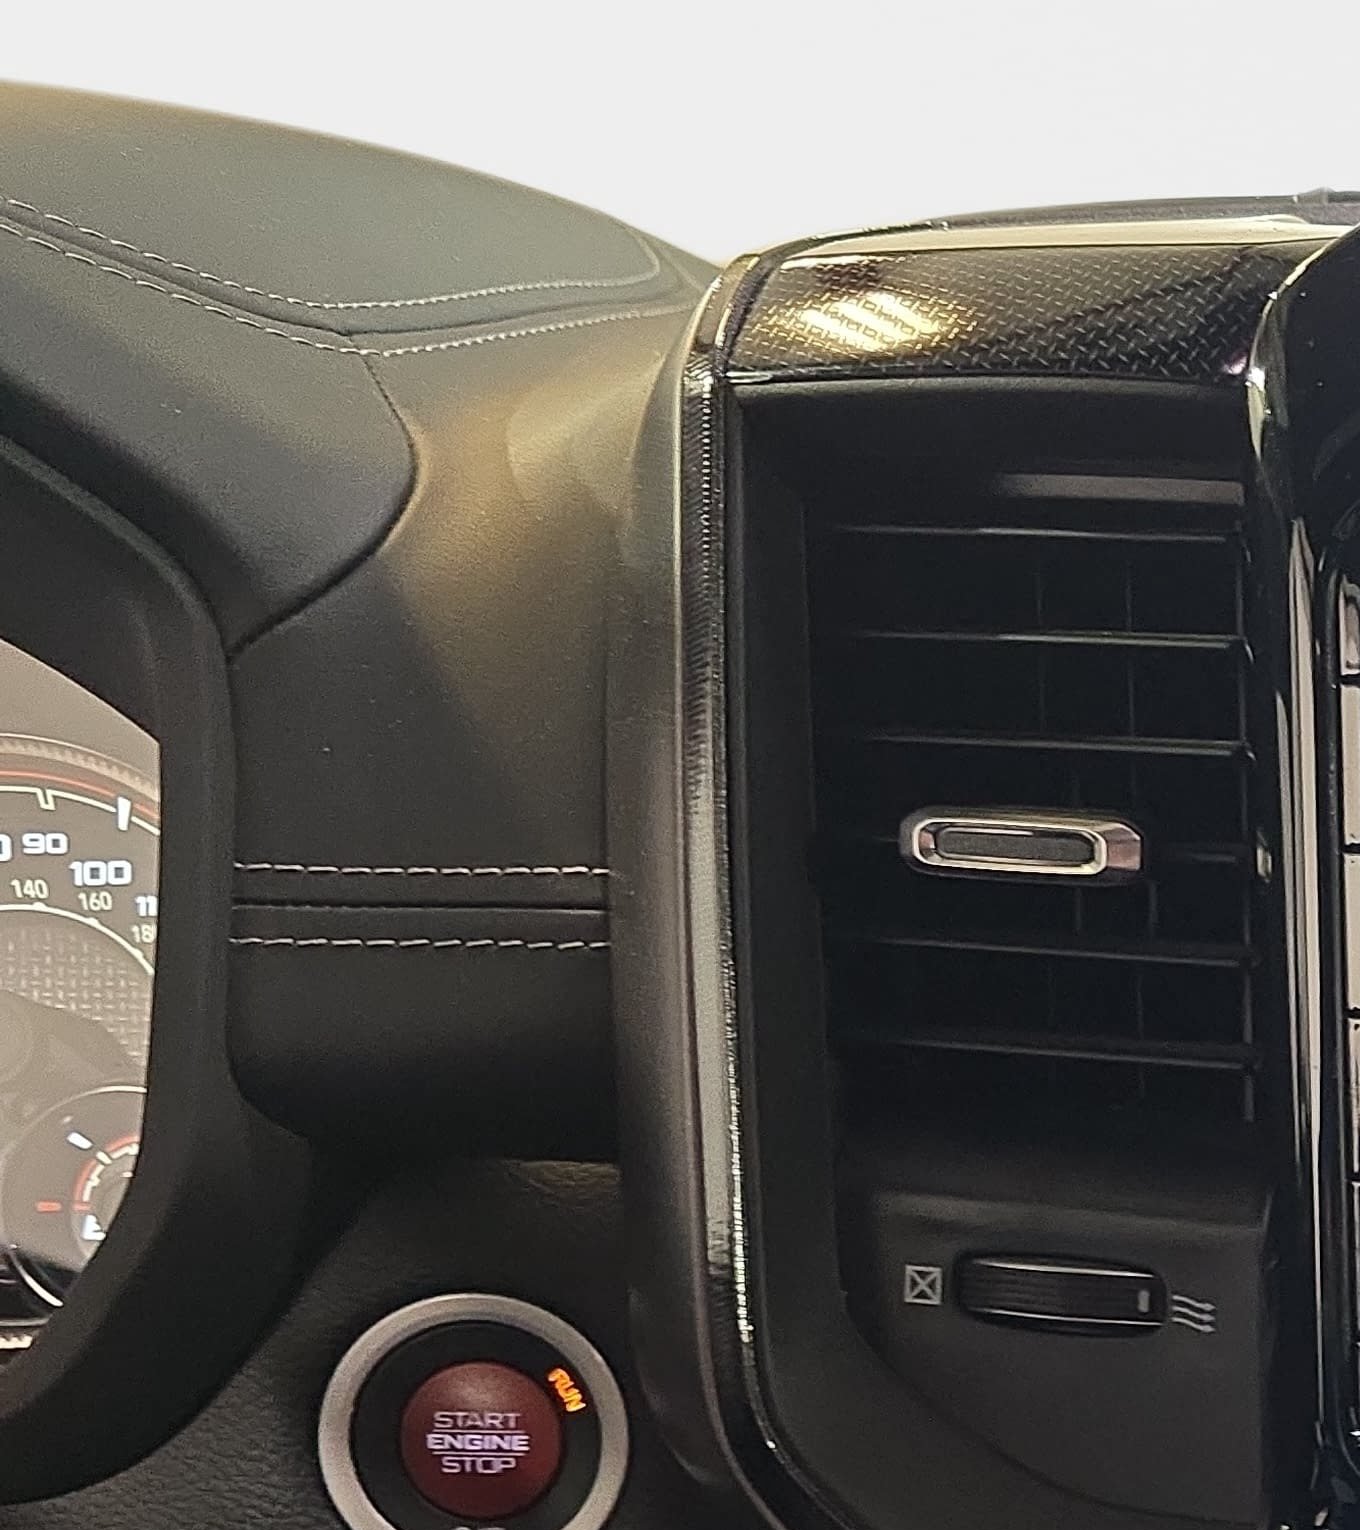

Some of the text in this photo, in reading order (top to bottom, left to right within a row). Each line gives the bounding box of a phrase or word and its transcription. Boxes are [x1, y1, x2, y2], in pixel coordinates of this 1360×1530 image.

[22, 832, 69, 855] 90
[69, 859, 133, 887] 100
[11, 879, 49, 899] 140
[78, 891, 113, 911] 160
[135, 895, 159, 917] 11
[132, 924, 156, 943] 18
[548, 1368, 587, 1412] RUN
[433, 1411, 520, 1429] START
[426, 1433, 530, 1451] ENGINE
[440, 1457, 517, 1474] STOP
